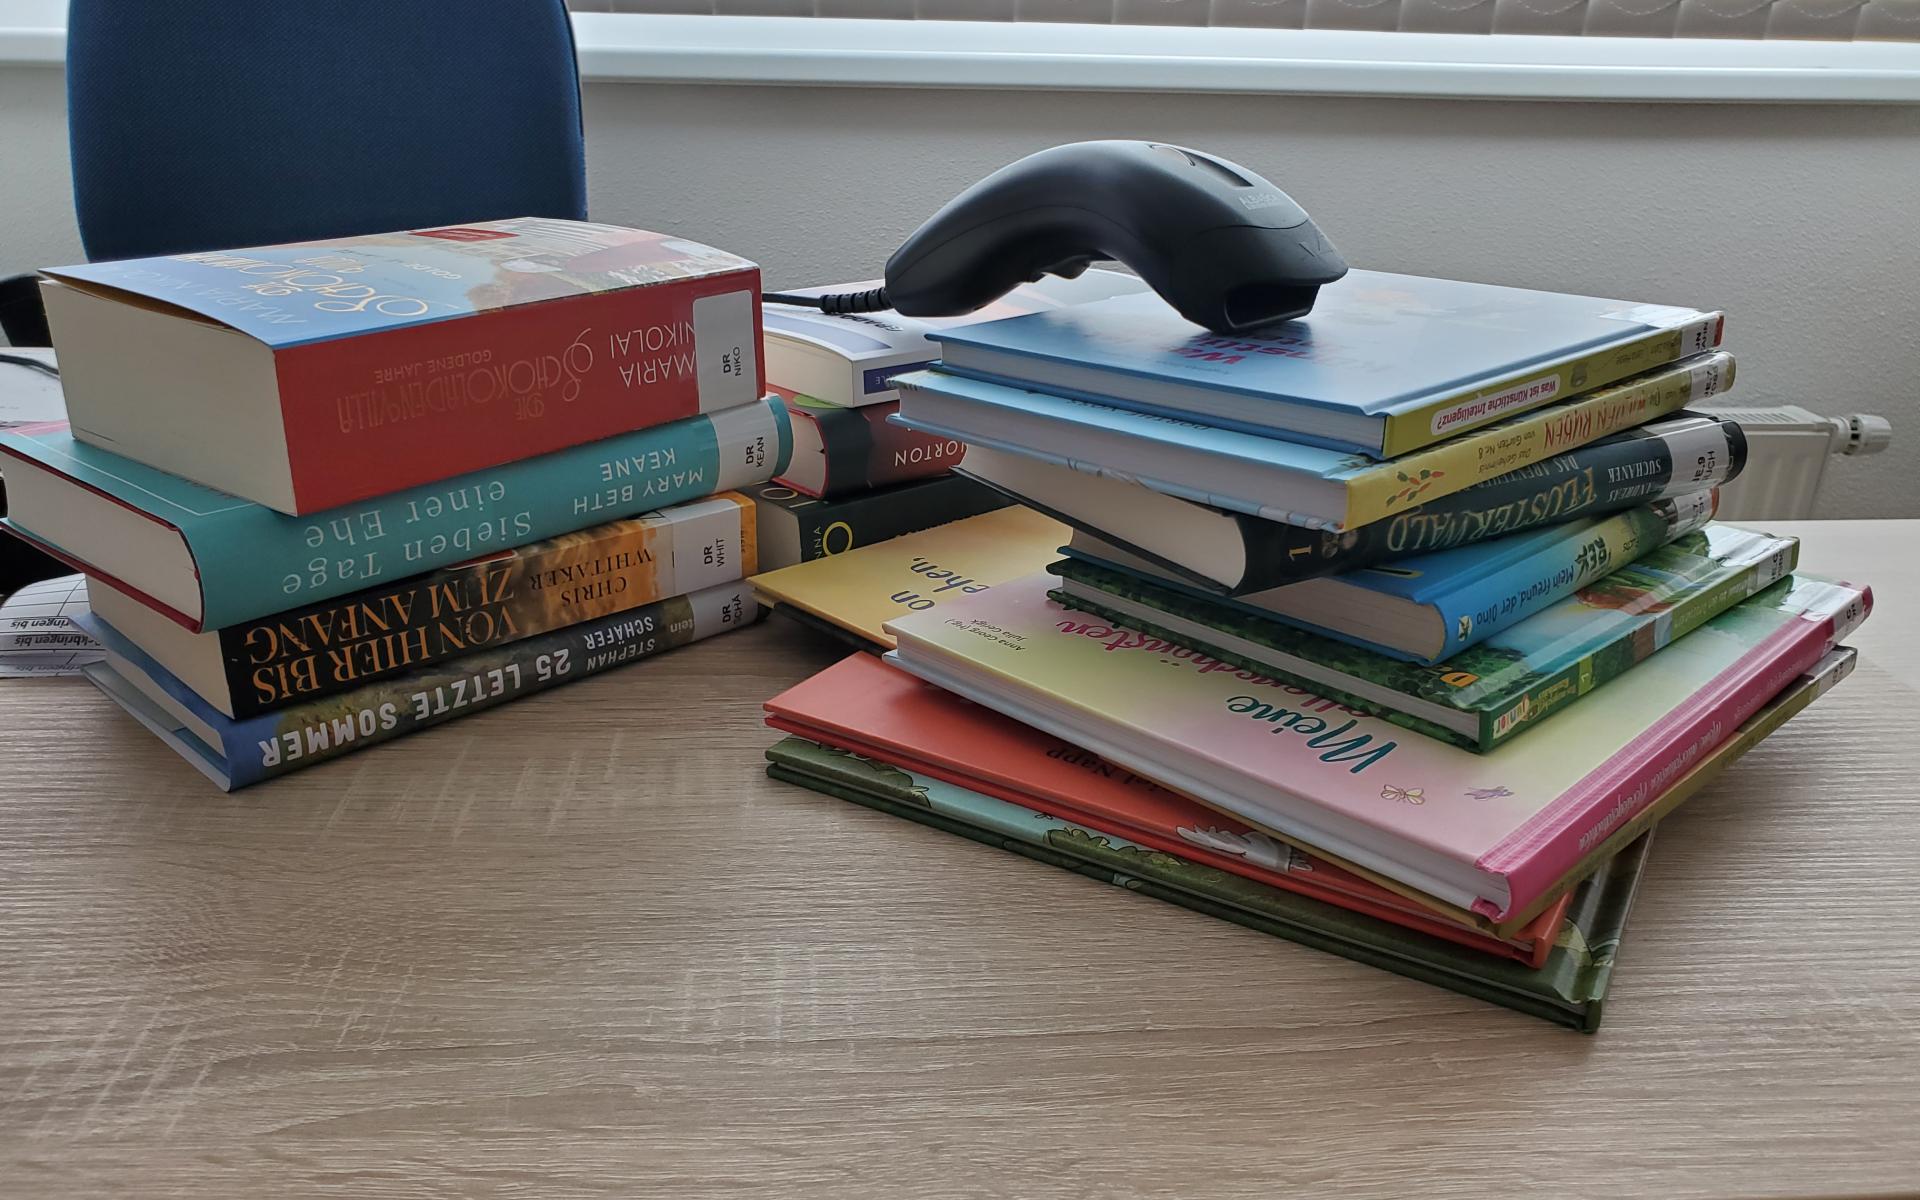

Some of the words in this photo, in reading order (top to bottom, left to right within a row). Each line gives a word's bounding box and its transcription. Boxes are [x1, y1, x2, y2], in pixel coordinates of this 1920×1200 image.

[374, 362, 423, 385] JAHRE
[428, 349, 492, 371] GOLDENE
[619, 351, 695, 388] MARIA
[722, 353, 732, 374] DR
[732, 346, 742, 377] NIKO
[1487, 389, 1528, 412] Künstliche
[1529, 385, 1539, 398] ist
[1541, 380, 1556, 394] Was
[1436, 401, 1486, 431] Intelligenz?
[600, 448, 676, 482] KEANE
[745, 444, 755, 465] DR
[756, 436, 764, 467] KEAN
[643, 467, 704, 497] MARY
[1607, 458, 1662, 483] SUCHANEK
[405, 480, 505, 525] einer
[573, 484, 633, 515] BETH
[303, 510, 388, 548] Ehe
[404, 511, 532, 562] Sieben
[703, 545, 713, 565] DR
[717, 538, 726, 568] WHIT
[282, 552, 382, 594] Tage
[530, 548, 653, 591] WHITAKER
[560, 576, 628, 608] CHRIS
[1502, 594, 1519, 614] der
[10, 620, 30, 630] bis
[244, 590, 417, 665] ANFANG
[721, 604, 732, 623] DR
[1476, 602, 1497, 624] Dino
[14, 635, 32, 647] bis
[440, 605, 520, 655] VON
[583, 616, 655, 650] SCHÄFER
[998, 639, 1027, 652] Anna
[328, 626, 432, 683] HIER
[535, 648, 572, 682] 25
[586, 638, 656, 671] STEPHAN
[252, 655, 322, 704] BIS
[411, 664, 522, 721] LETZTE
[257, 702, 397, 768] SOMMER
[1226, 694, 1399, 775] Meine
